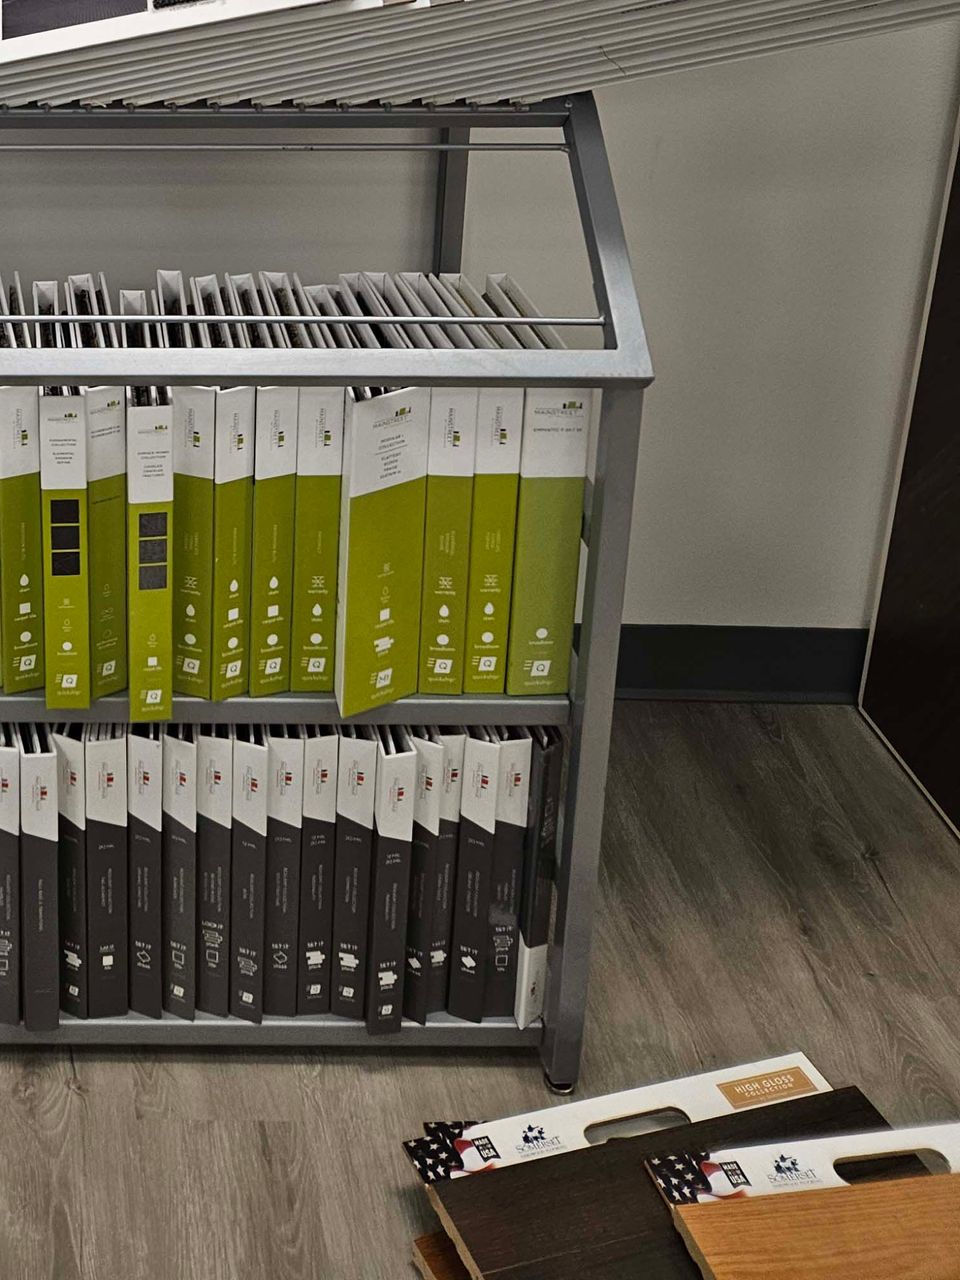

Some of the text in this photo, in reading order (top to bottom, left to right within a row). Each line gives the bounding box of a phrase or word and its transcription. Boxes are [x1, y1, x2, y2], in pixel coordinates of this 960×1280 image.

[734, 1074, 795, 1096] HIGH GLOSS
[745, 1082, 794, 1098] COLLECTION
